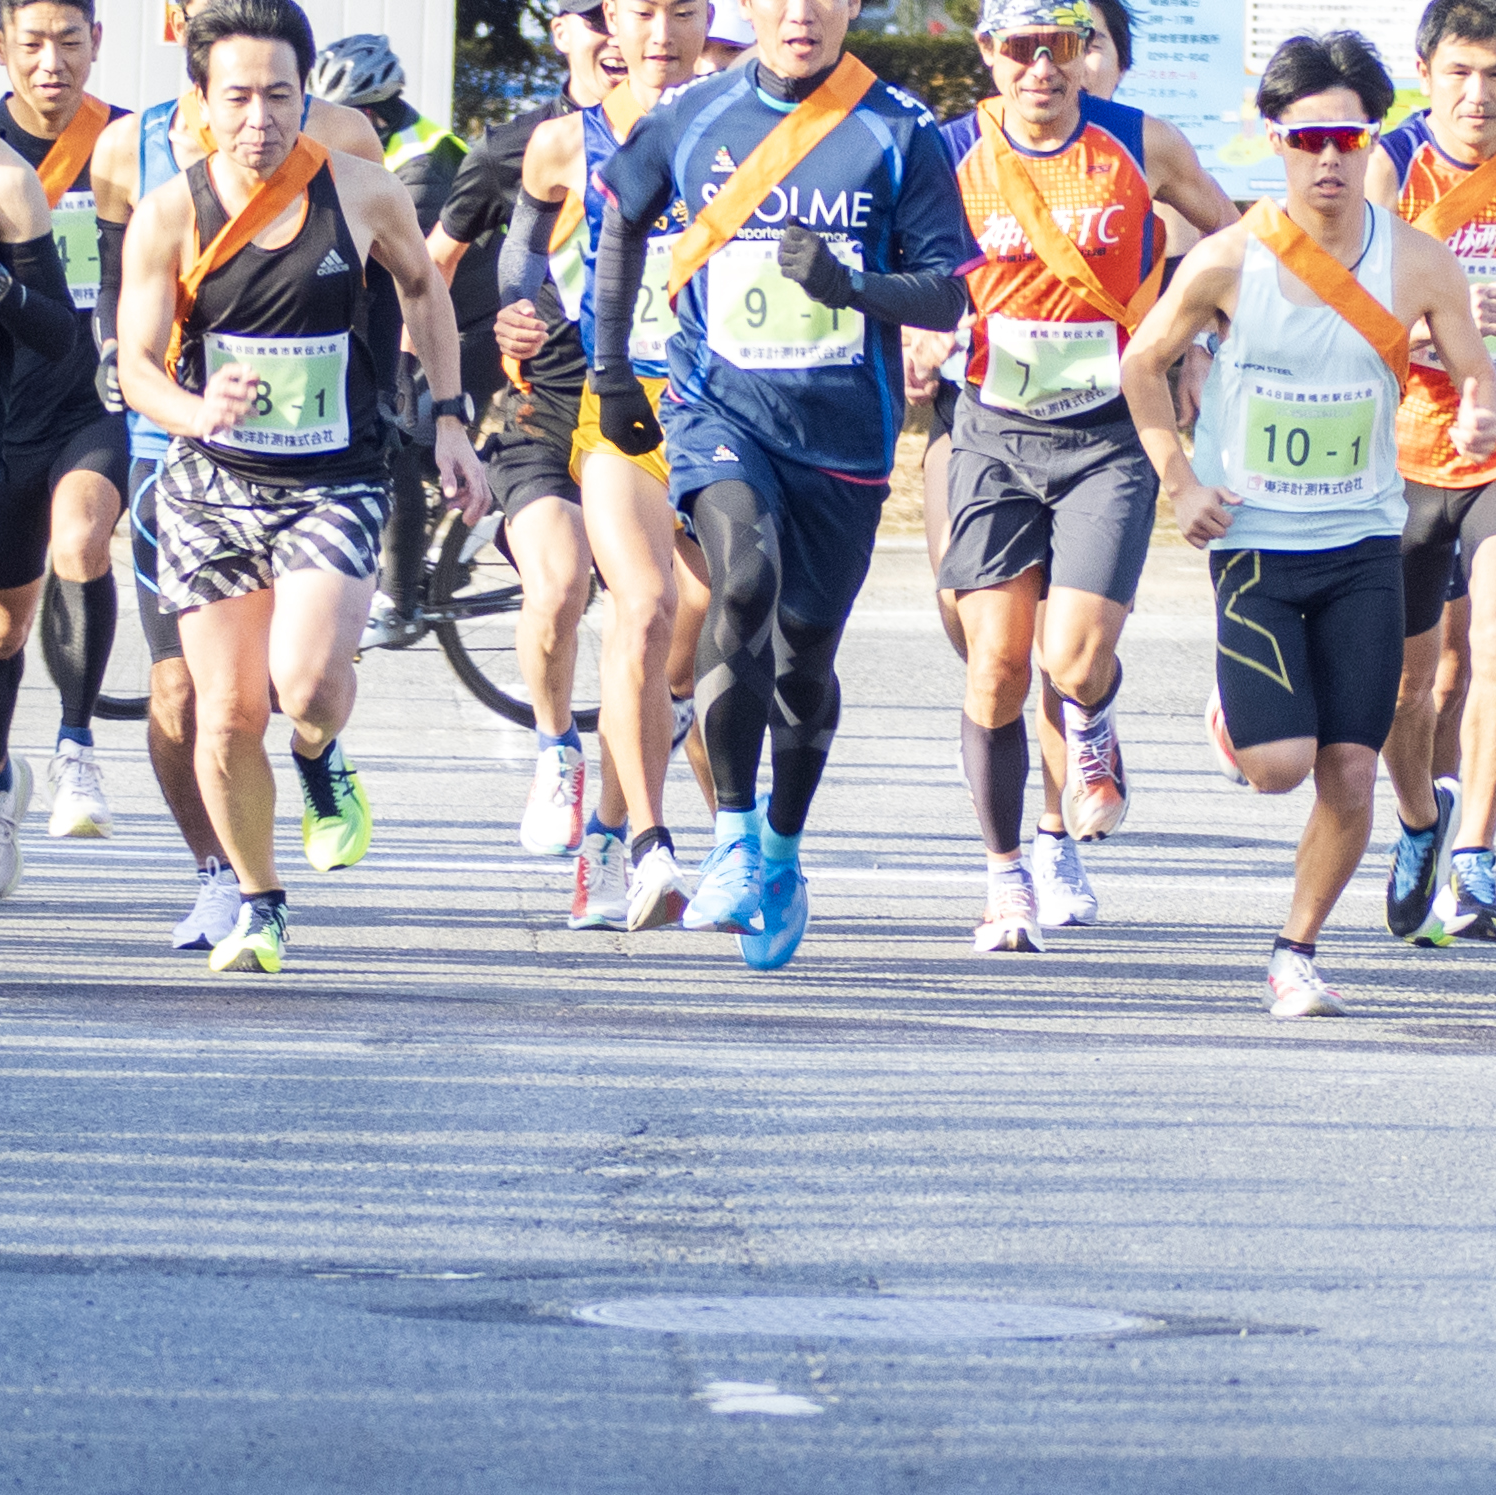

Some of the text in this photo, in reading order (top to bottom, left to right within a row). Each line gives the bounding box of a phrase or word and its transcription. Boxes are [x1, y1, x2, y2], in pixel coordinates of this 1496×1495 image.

[1264, 476, 1364, 496] 東洋計測株式会社
